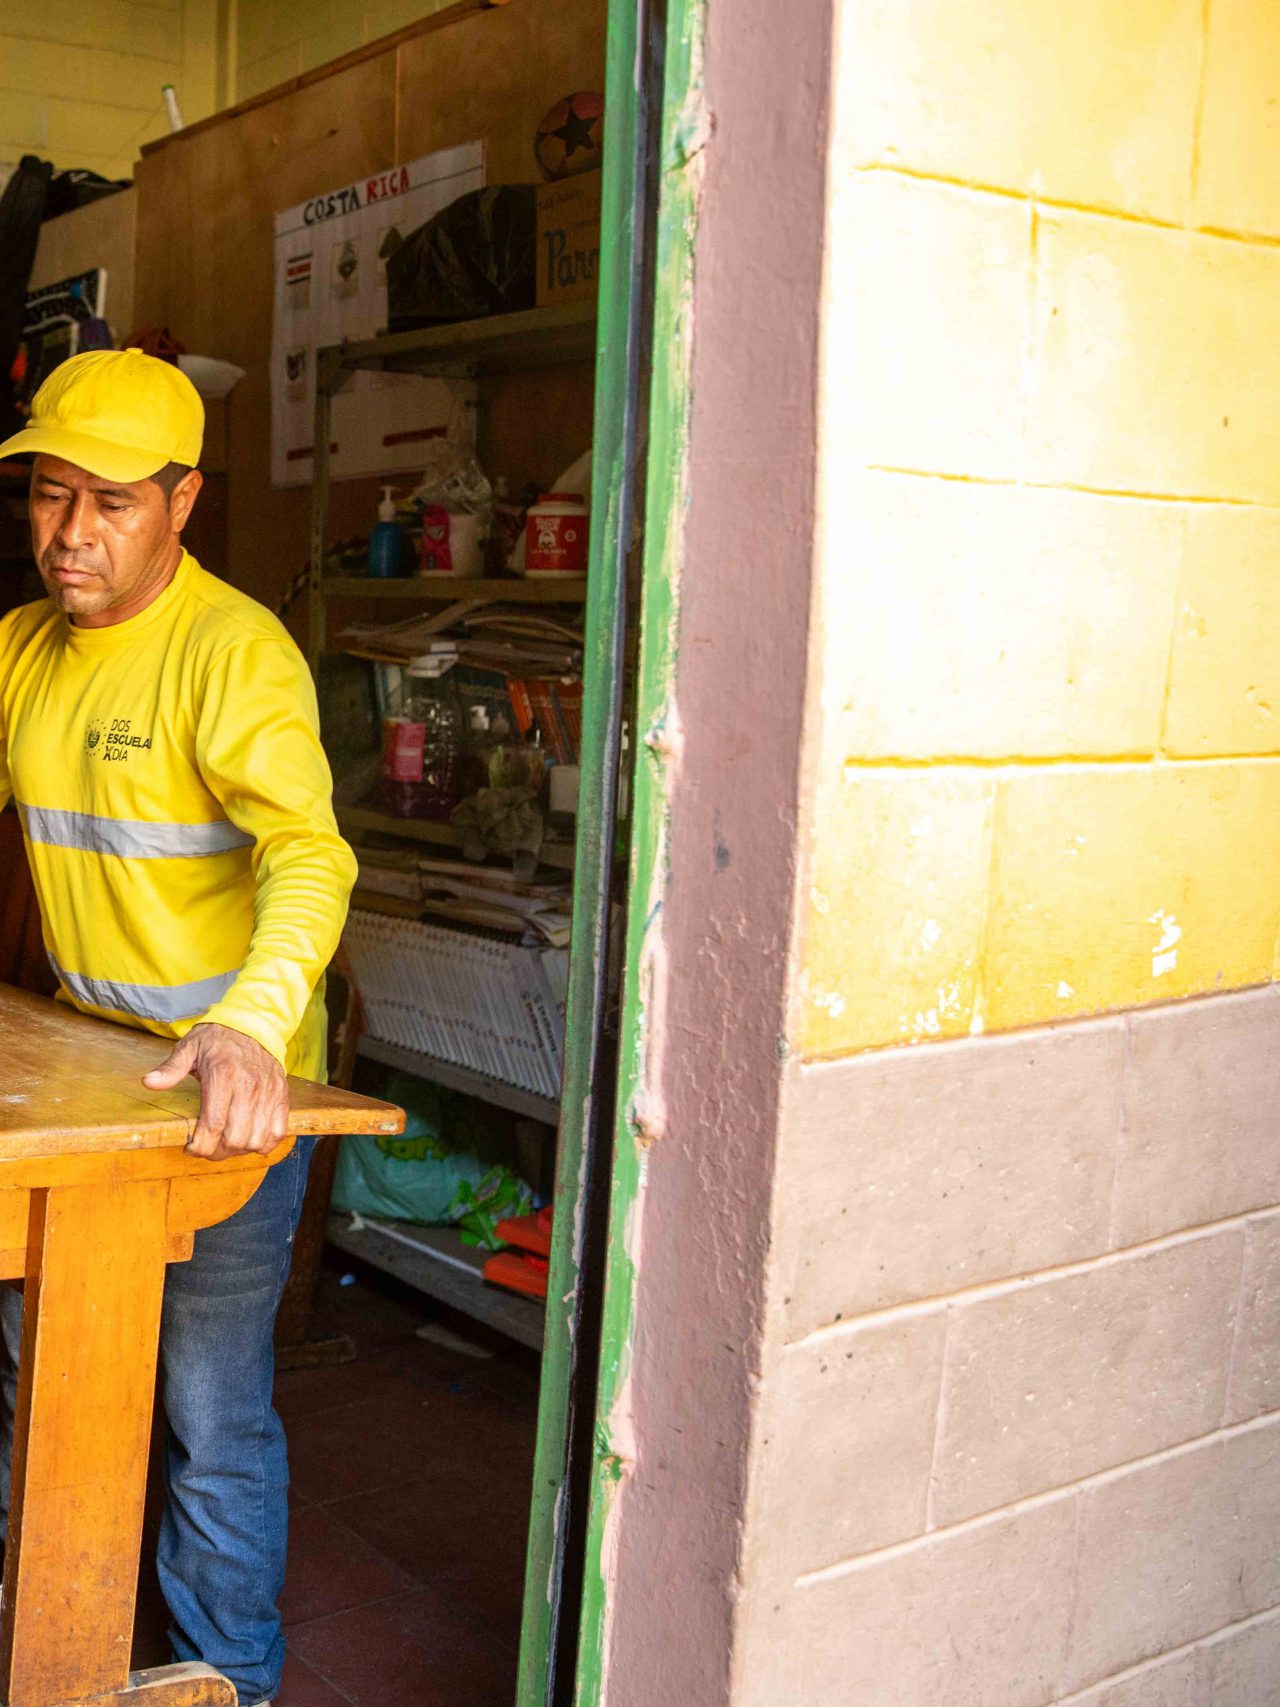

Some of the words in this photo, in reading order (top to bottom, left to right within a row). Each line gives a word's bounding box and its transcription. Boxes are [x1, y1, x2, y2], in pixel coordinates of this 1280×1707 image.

[303, 185, 360, 225] COSTA
[366, 166, 410, 204] RICA
[110, 718, 131, 732] DOS
